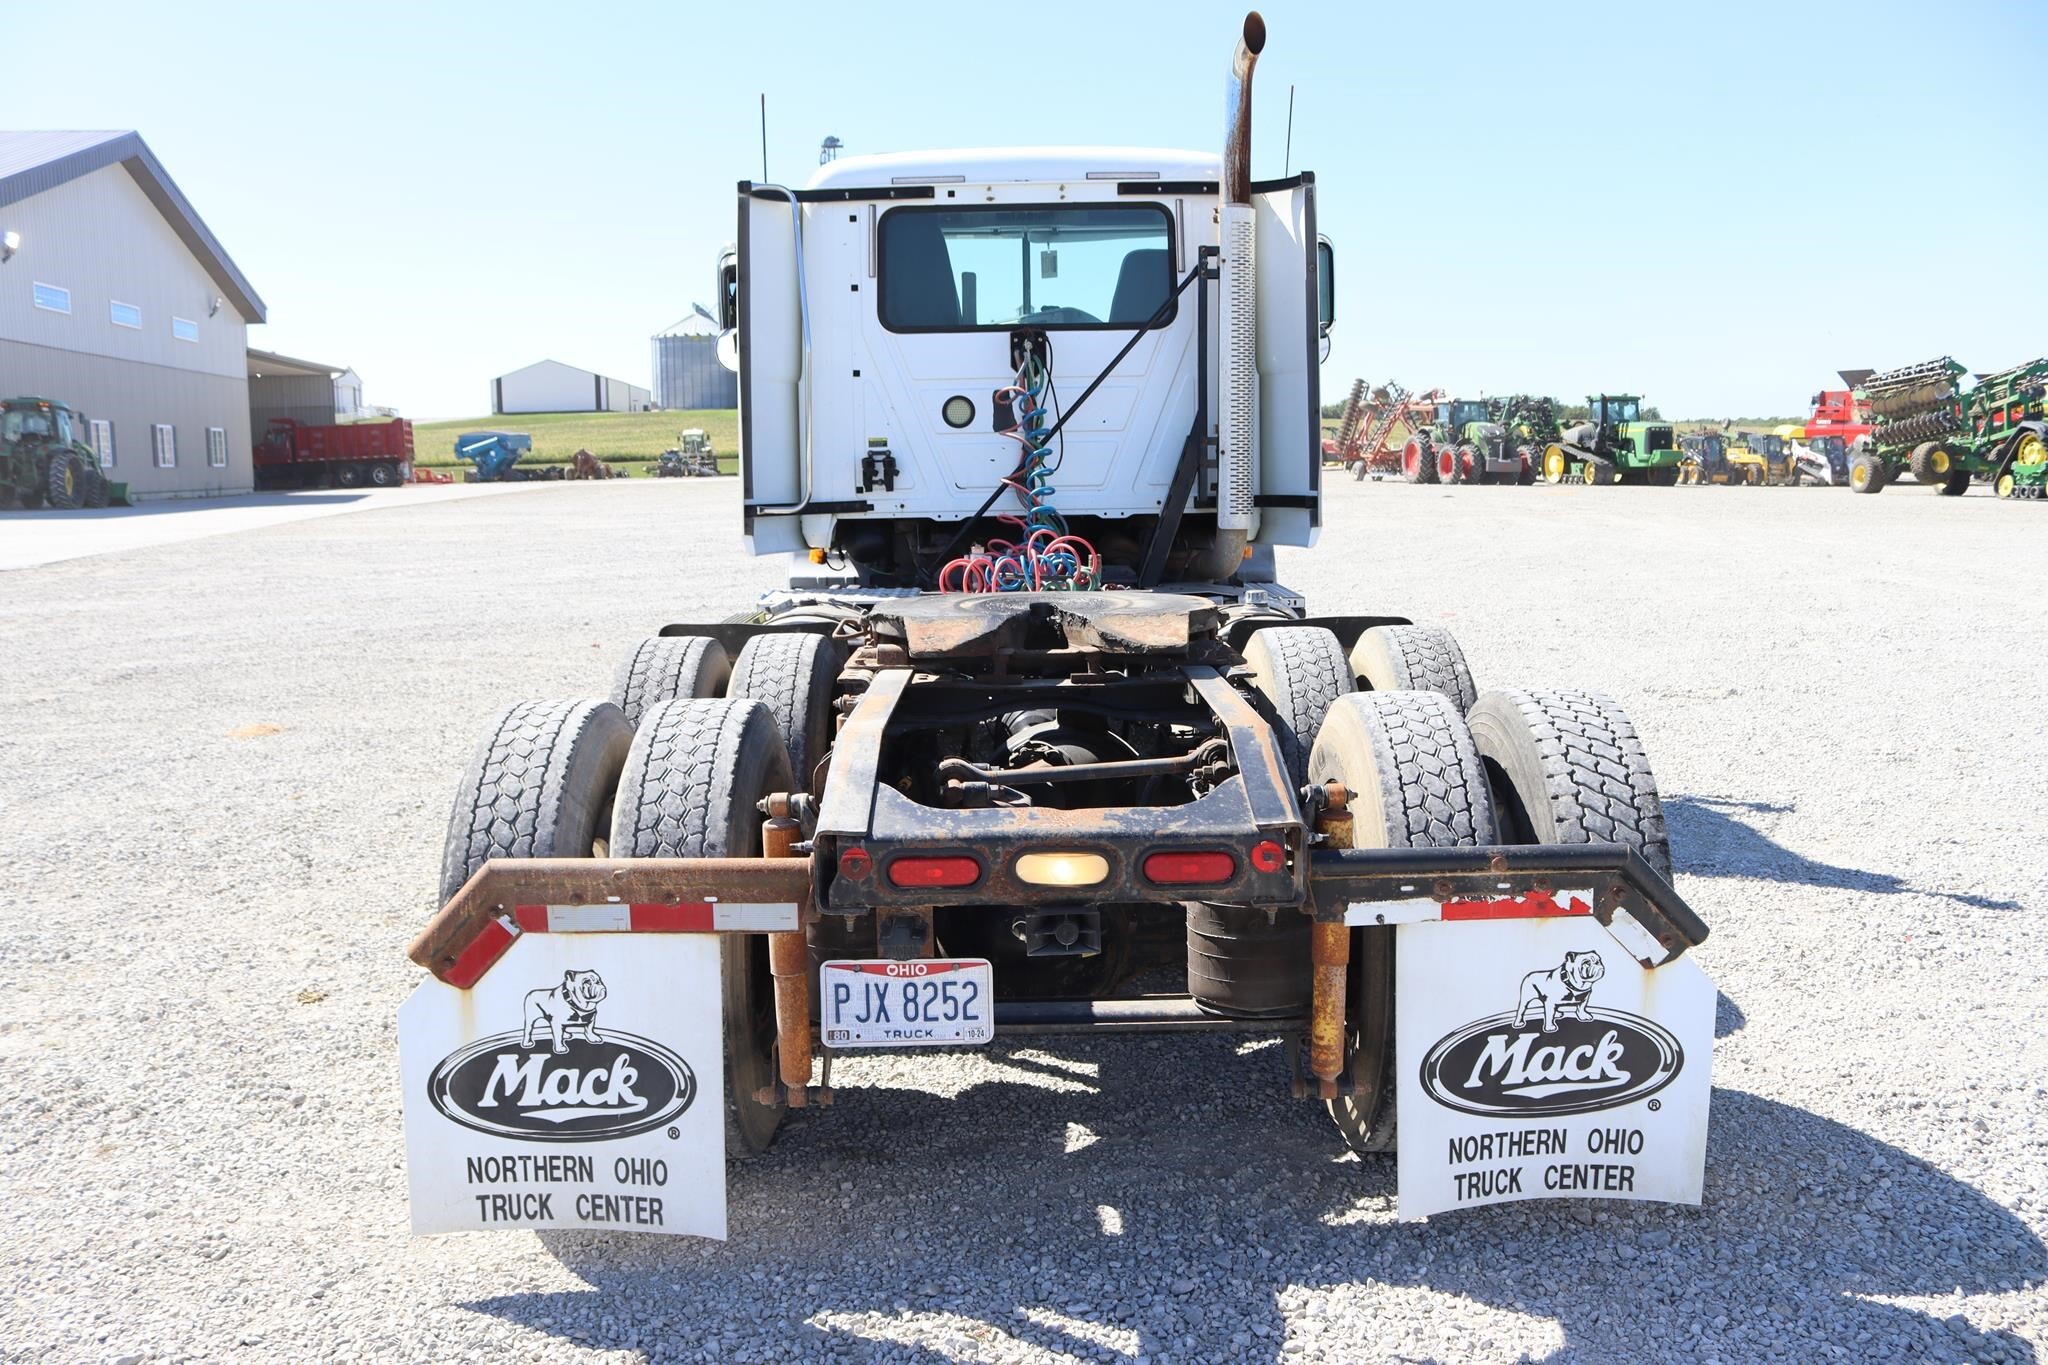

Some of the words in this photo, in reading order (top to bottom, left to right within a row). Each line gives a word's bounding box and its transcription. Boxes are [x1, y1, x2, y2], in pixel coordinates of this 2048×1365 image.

[886, 964, 927, 976] OHIO
[833, 982, 891, 1024] PJX
[903, 981, 979, 1022] 8252
[833, 1030, 848, 1040] 80
[884, 1029, 933, 1039] TRUCK
[1463, 1030, 1631, 1099] Mack
[477, 1053, 648, 1123] Mack
[1449, 1128, 1567, 1164] NORTHERN
[1587, 1128, 1644, 1155] OHIO
[467, 1155, 593, 1184] NORTHERN
[614, 1157, 668, 1186] OHIO
[1454, 1167, 1522, 1200] TRUCK
[1544, 1164, 1634, 1192] CENTER
[476, 1193, 554, 1222] TRUCK
[576, 1194, 663, 1226] CENTER
